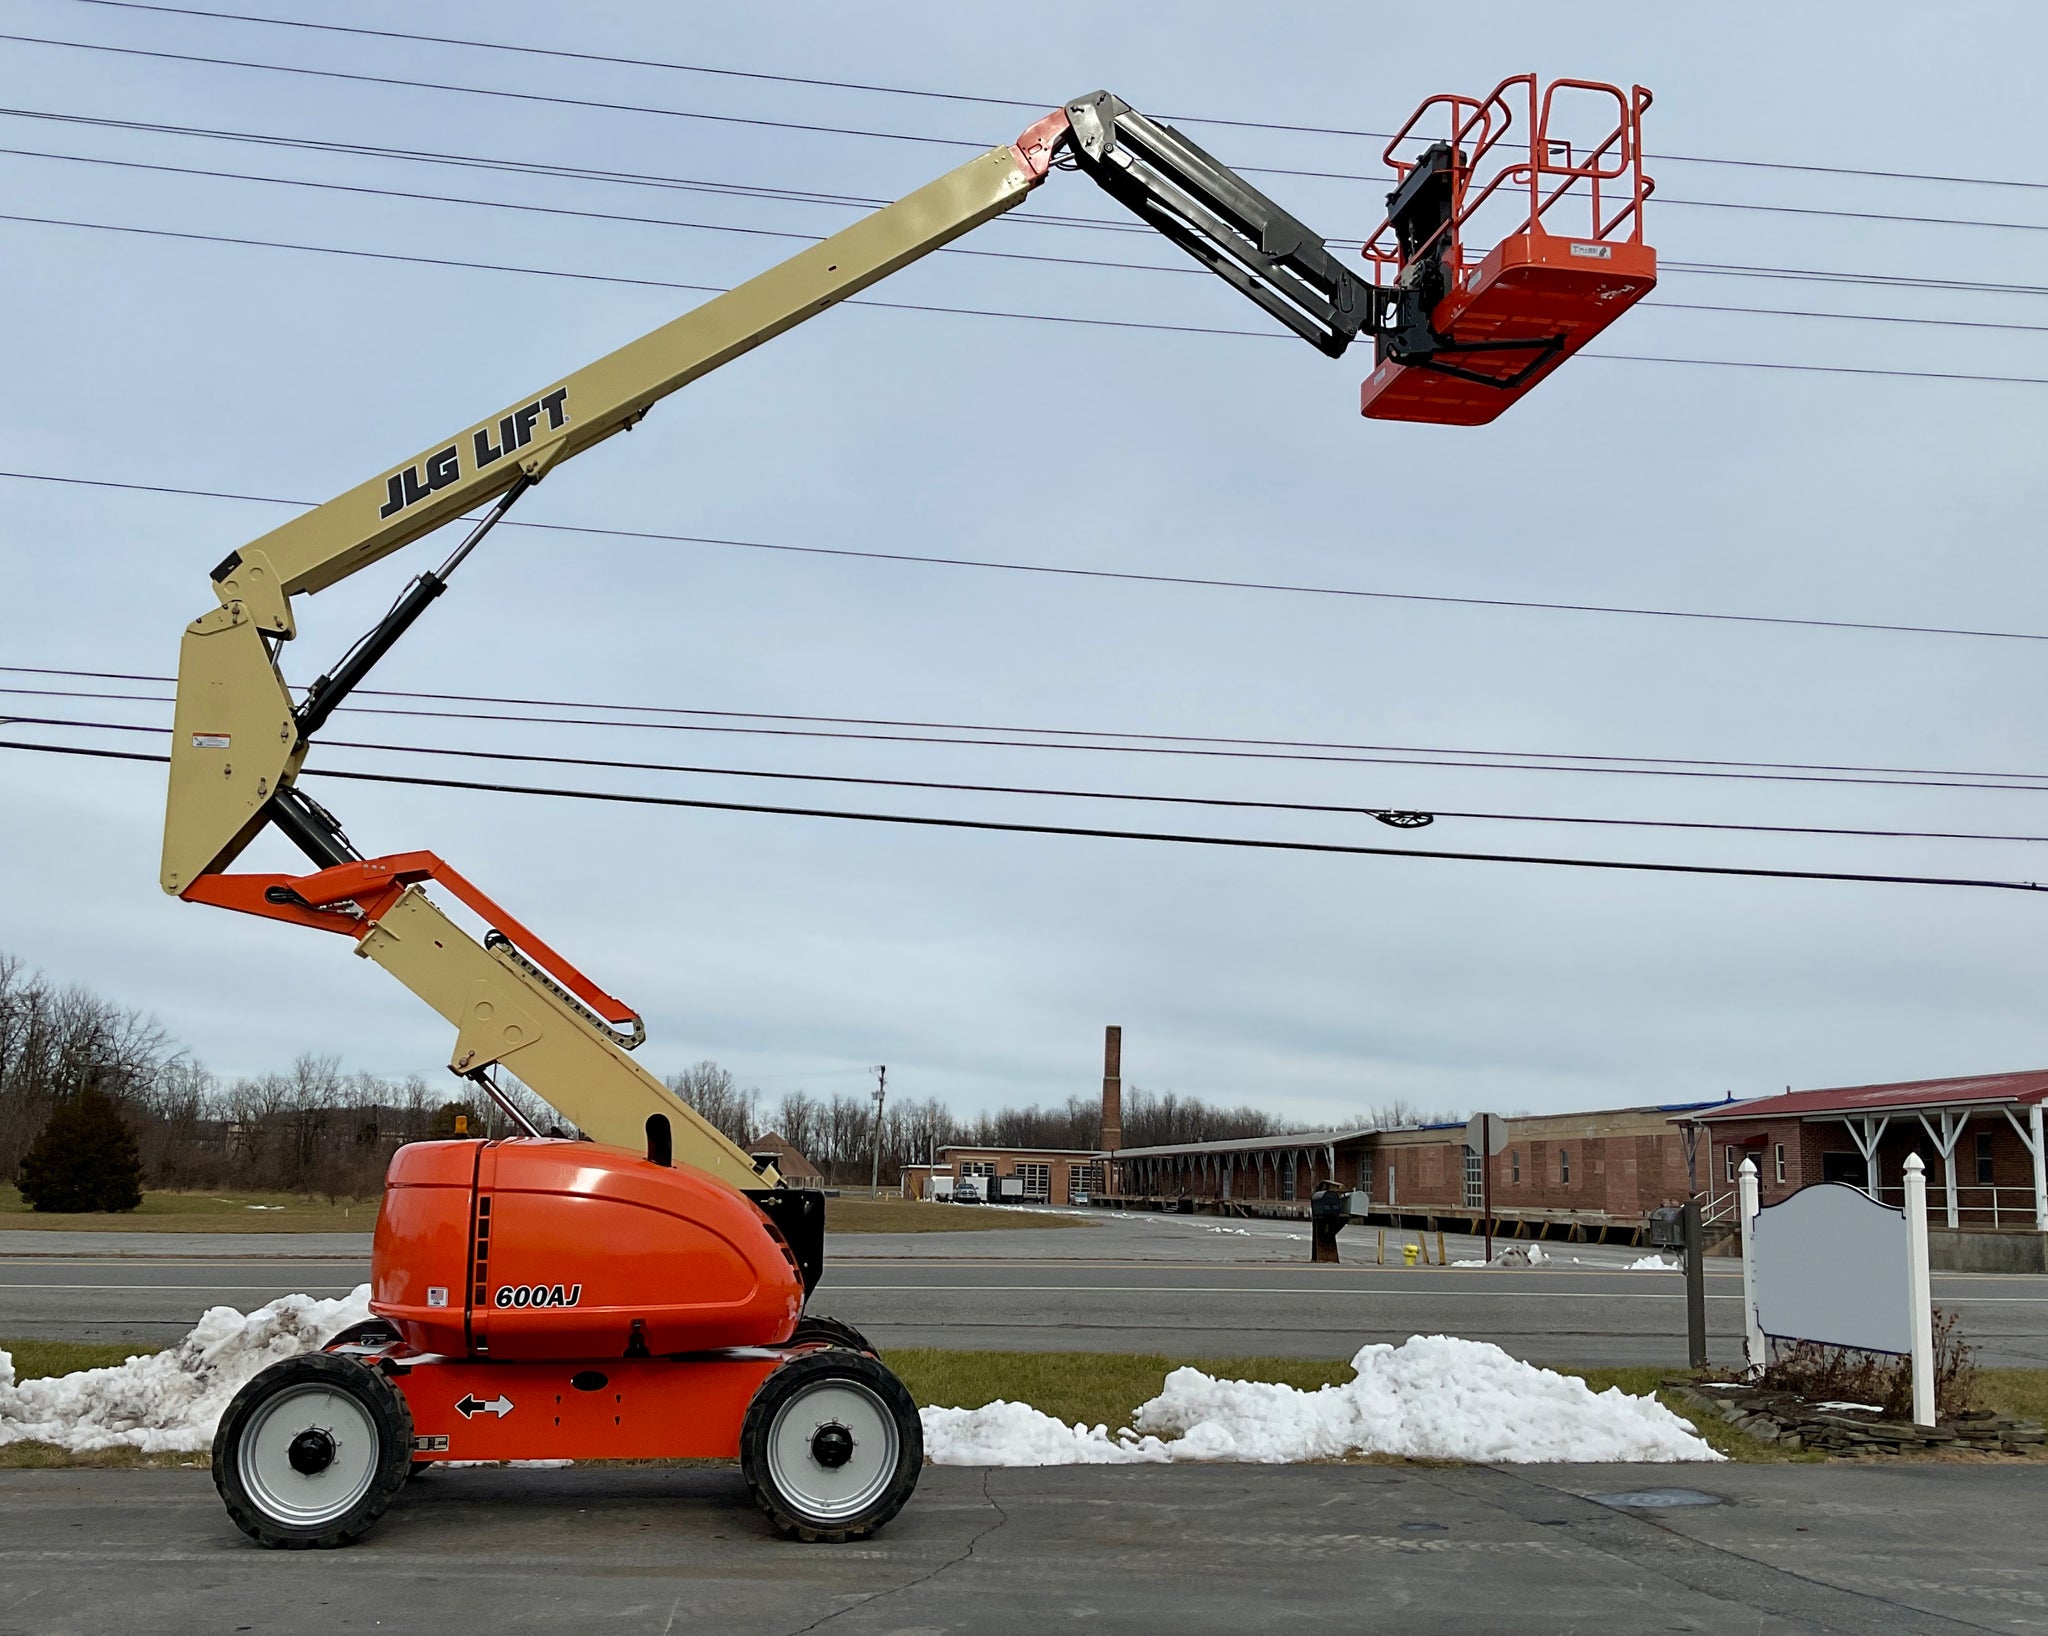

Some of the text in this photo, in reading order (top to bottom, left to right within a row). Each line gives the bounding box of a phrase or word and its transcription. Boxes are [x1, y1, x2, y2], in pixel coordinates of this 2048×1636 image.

[380, 386, 567, 520] JLG LIFT
[495, 1284, 581, 1308] 600AJ
